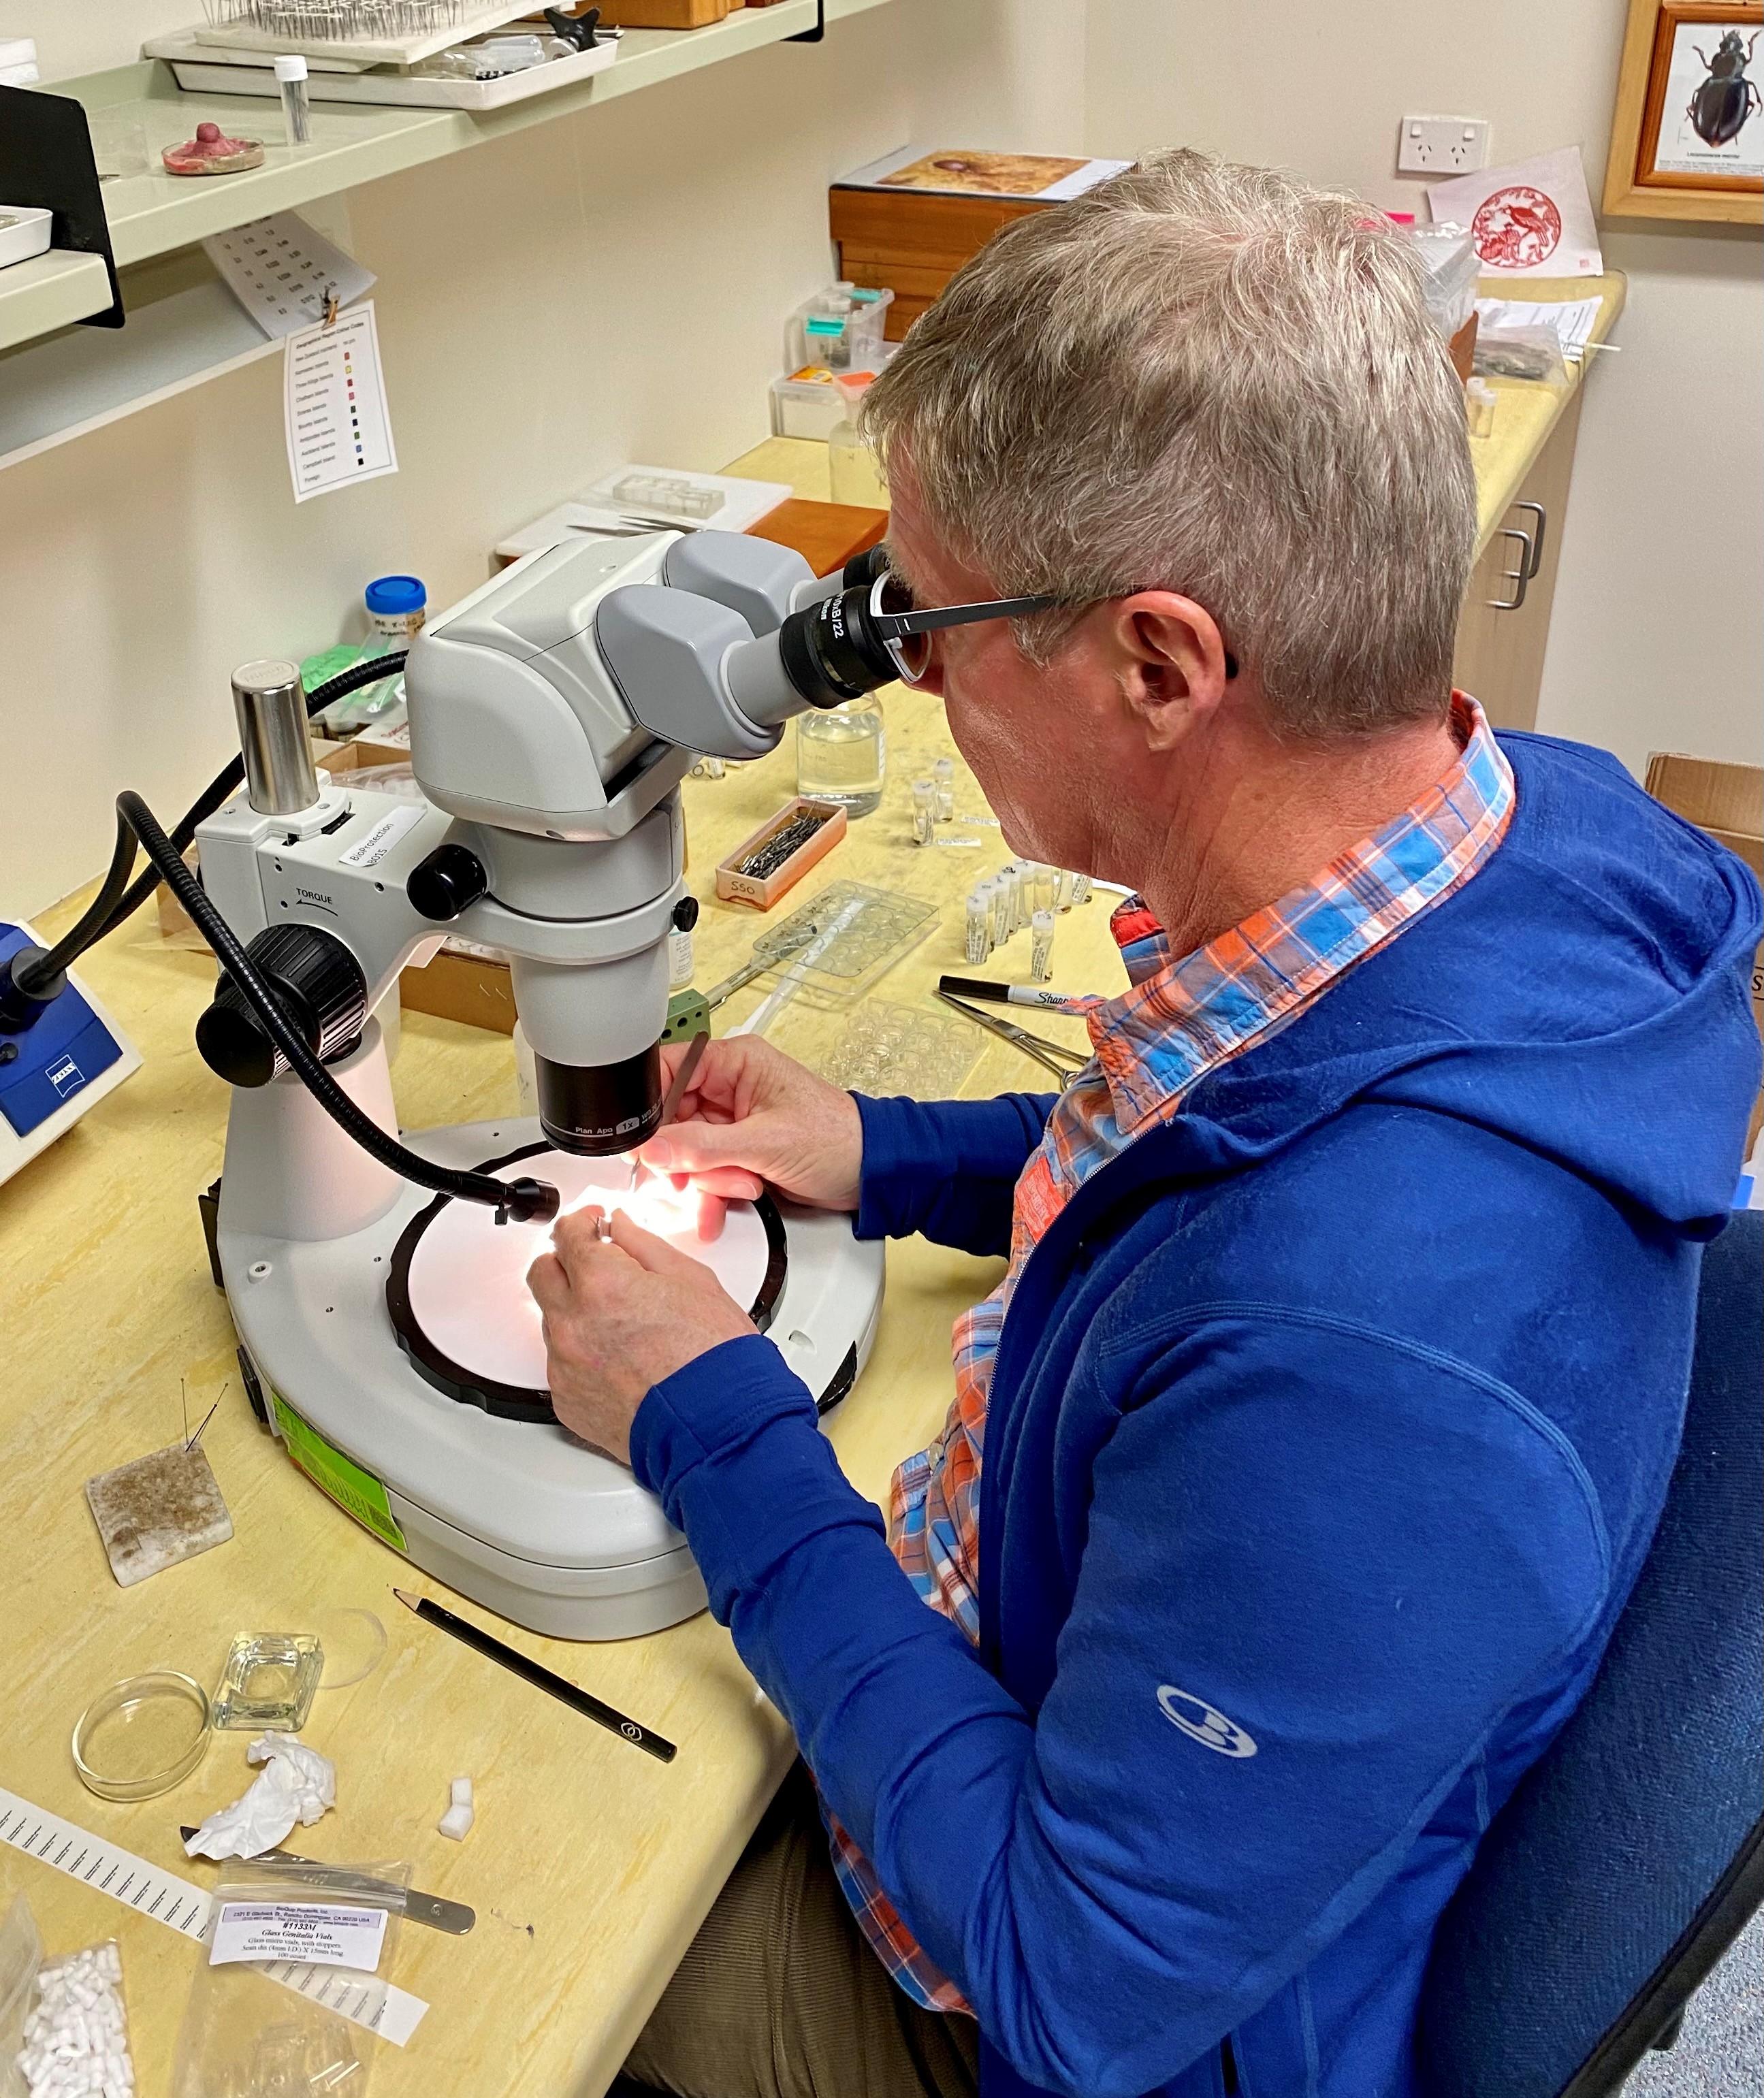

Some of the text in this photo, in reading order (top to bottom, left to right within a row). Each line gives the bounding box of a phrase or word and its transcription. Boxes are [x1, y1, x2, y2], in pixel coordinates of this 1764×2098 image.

[350, 822, 394, 861] BioProtection
[295, 888, 333, 905] TORQUE
[622, 1123, 634, 1131] 1x
[283, 1922, 317, 1931] #1133M
[283, 1931, 313, 1939] Genitalia
